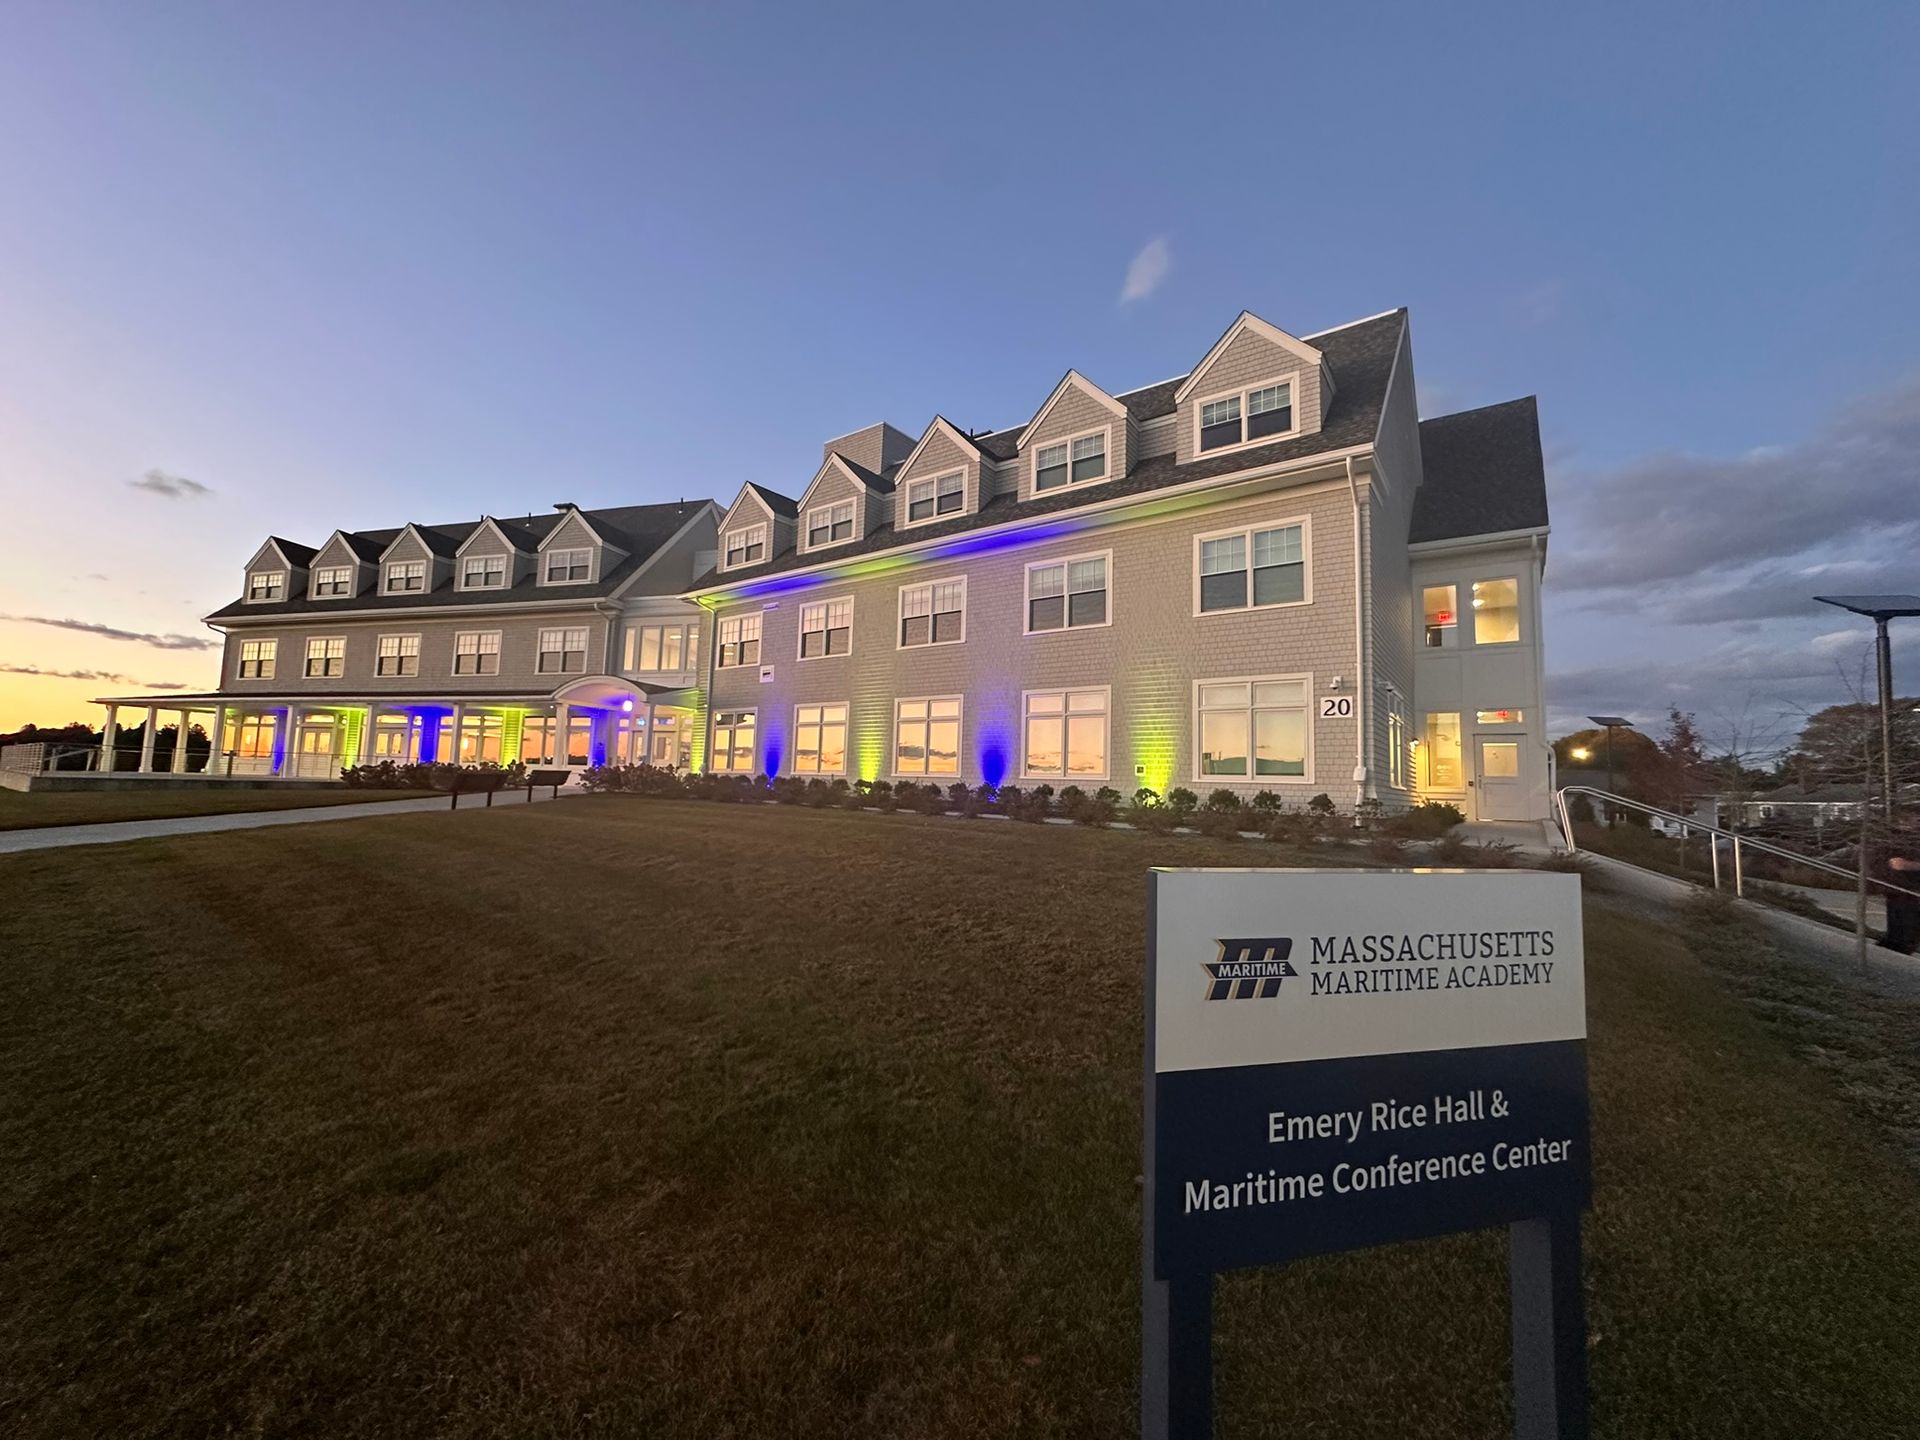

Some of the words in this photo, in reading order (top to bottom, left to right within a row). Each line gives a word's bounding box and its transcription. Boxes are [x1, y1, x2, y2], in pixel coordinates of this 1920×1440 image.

[1324, 699, 1350, 716] 20
[1310, 930, 1554, 965] MASSACHUSETTS
[1218, 962, 1287, 978] MARITIME
[1311, 967, 1439, 996] MARITIME
[1445, 962, 1554, 989] ACADEMY
[1268, 1109, 1363, 1144] Emery
[1371, 1099, 1427, 1131] Rice
[1434, 1091, 1484, 1125] Hall
[1490, 1090, 1509, 1118] &
[1184, 1170, 1324, 1214] Maritime
[1332, 1152, 1486, 1194] Conference
[1492, 1137, 1571, 1170] Center
